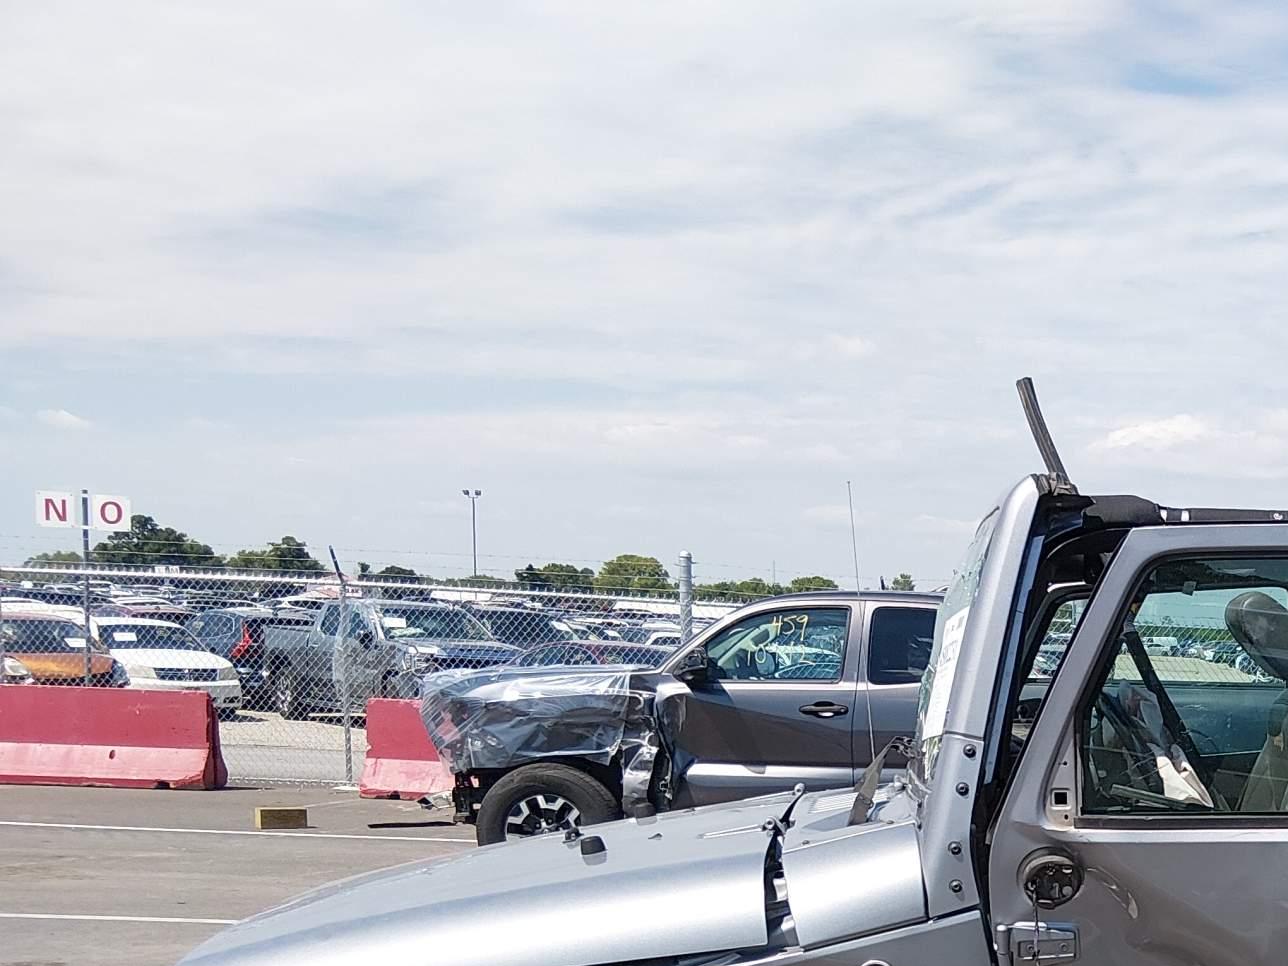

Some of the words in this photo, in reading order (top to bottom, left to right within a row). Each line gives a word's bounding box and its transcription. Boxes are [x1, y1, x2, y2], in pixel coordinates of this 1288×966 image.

[44, 498, 67, 522] N
[99, 501, 123, 524] O
[771, 614, 808, 641] 459
